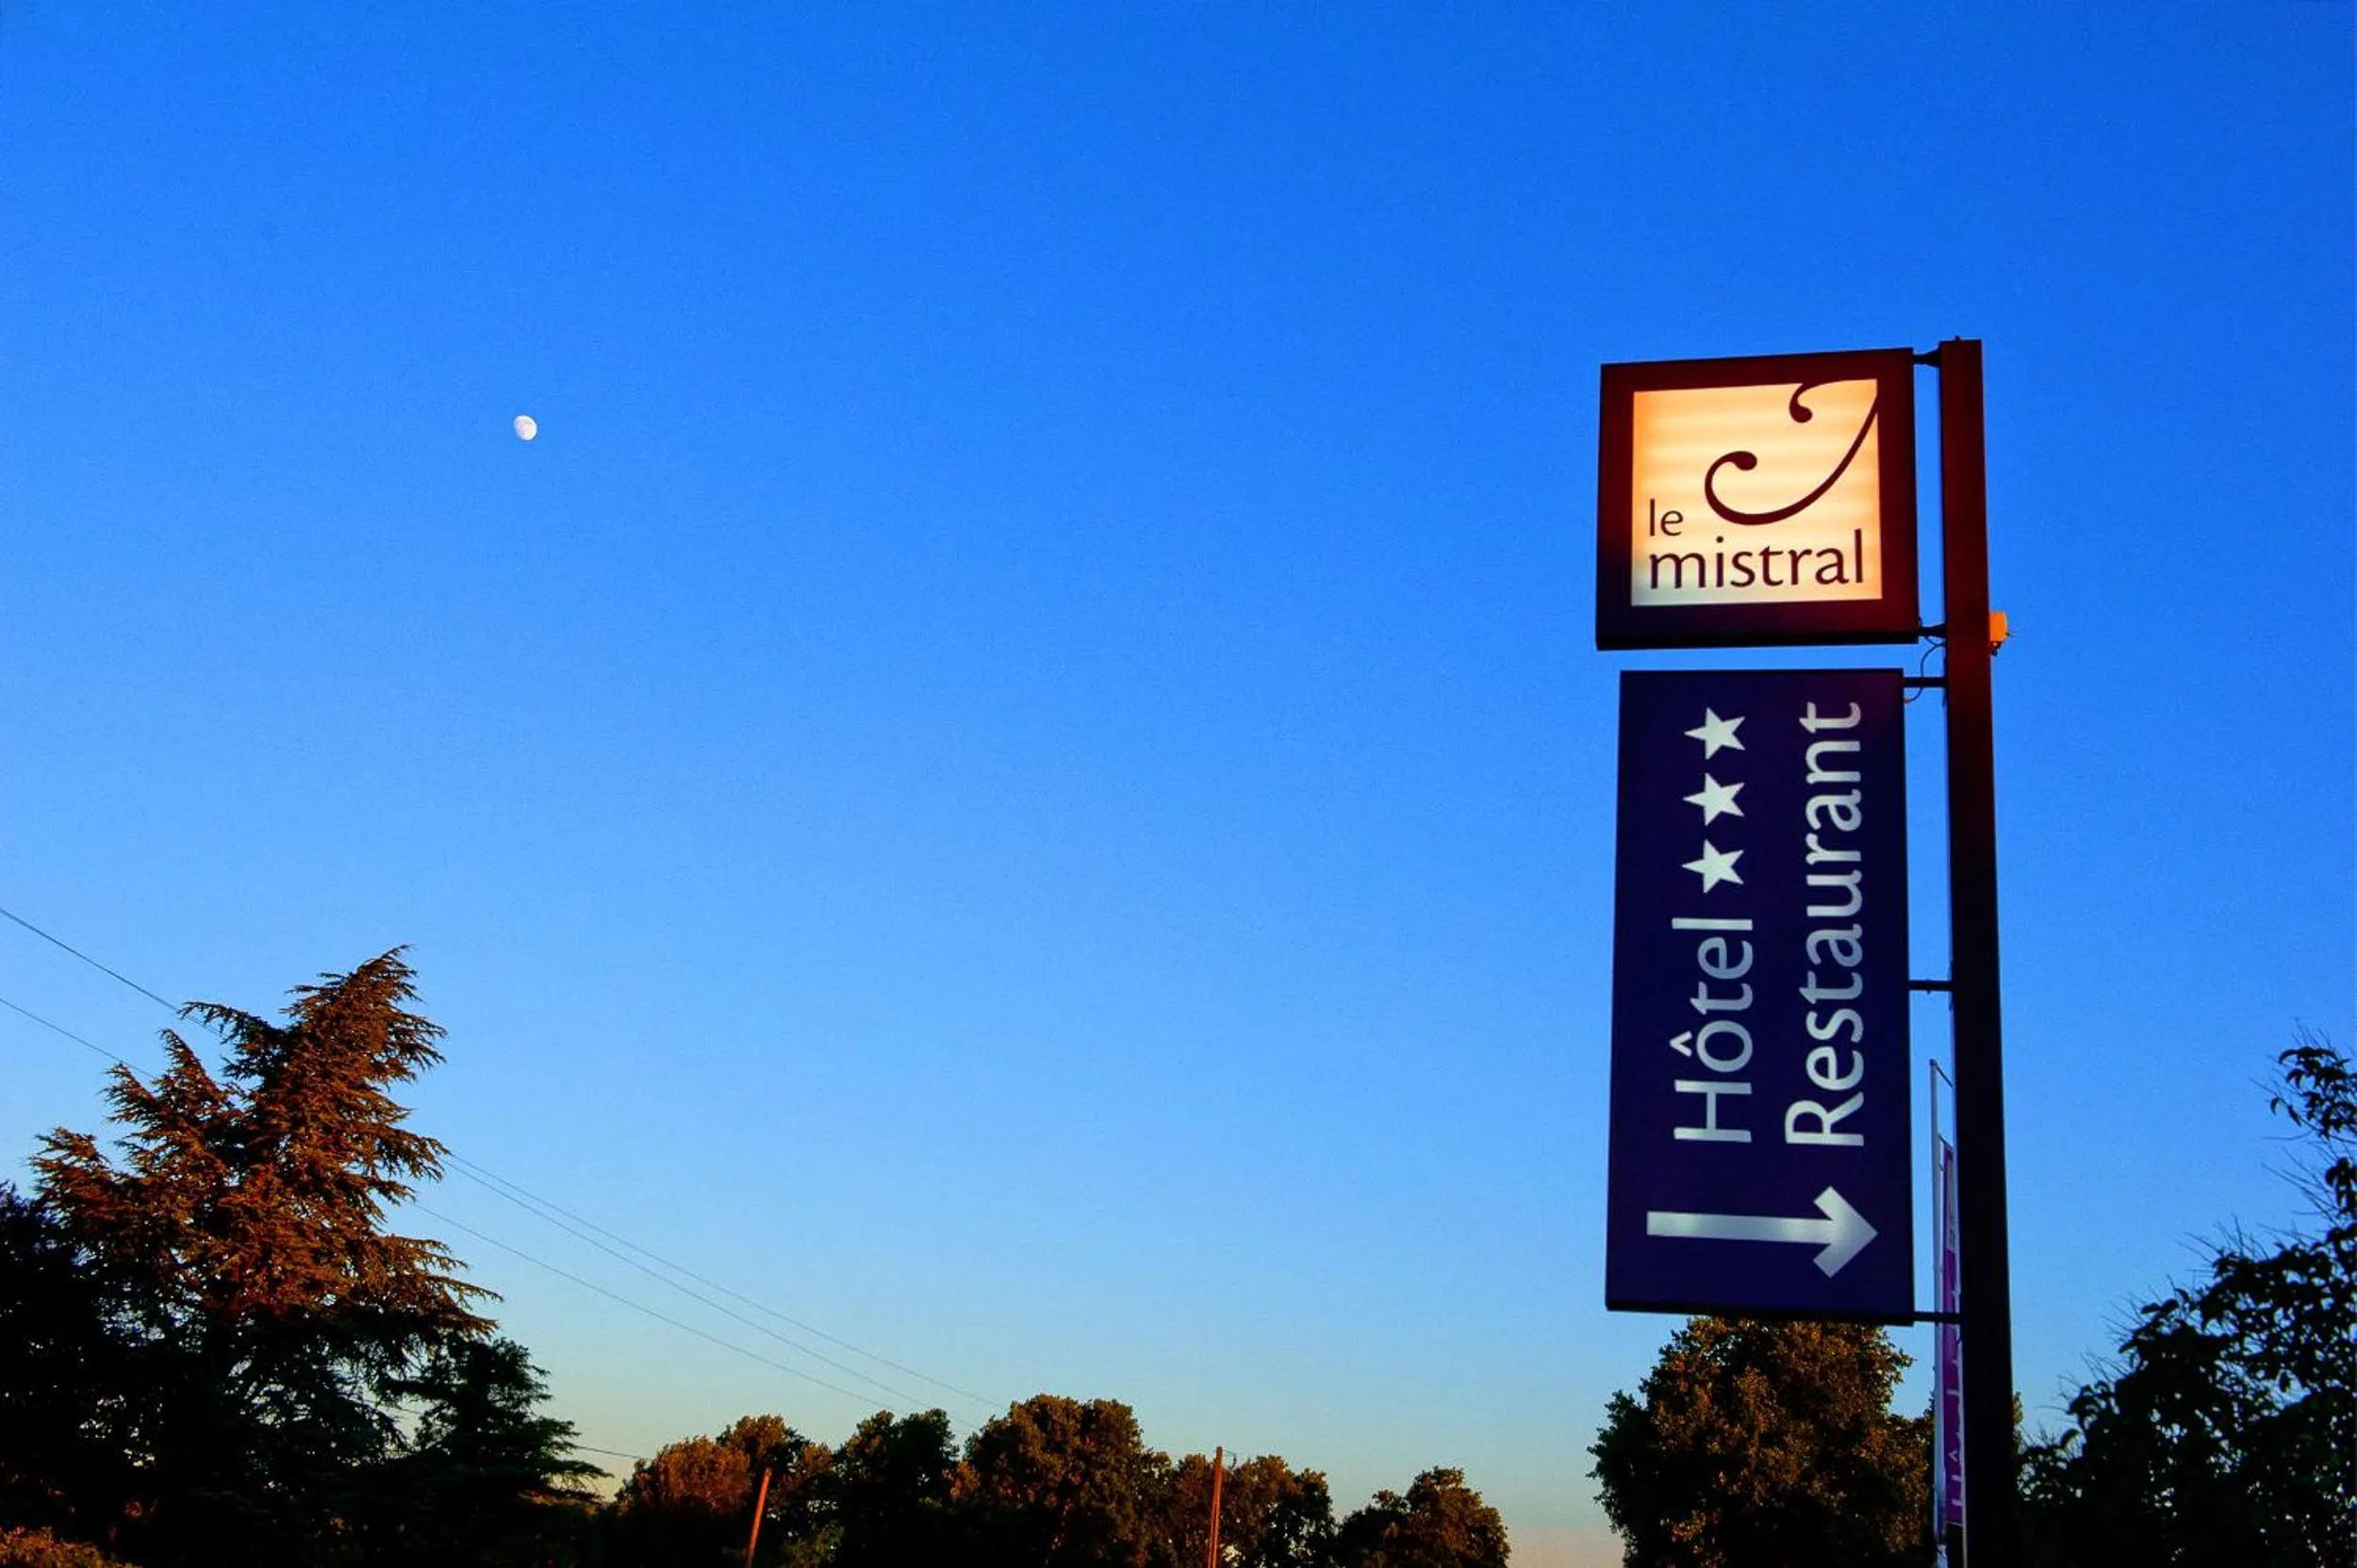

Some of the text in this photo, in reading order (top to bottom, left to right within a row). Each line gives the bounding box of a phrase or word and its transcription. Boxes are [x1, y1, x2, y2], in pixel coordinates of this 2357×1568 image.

[1649, 498, 1684, 536] le
[1649, 528, 1864, 589] mistral
[1785, 701, 1865, 1146] Restaurant
[1670, 916, 1754, 1143] Hôtel
